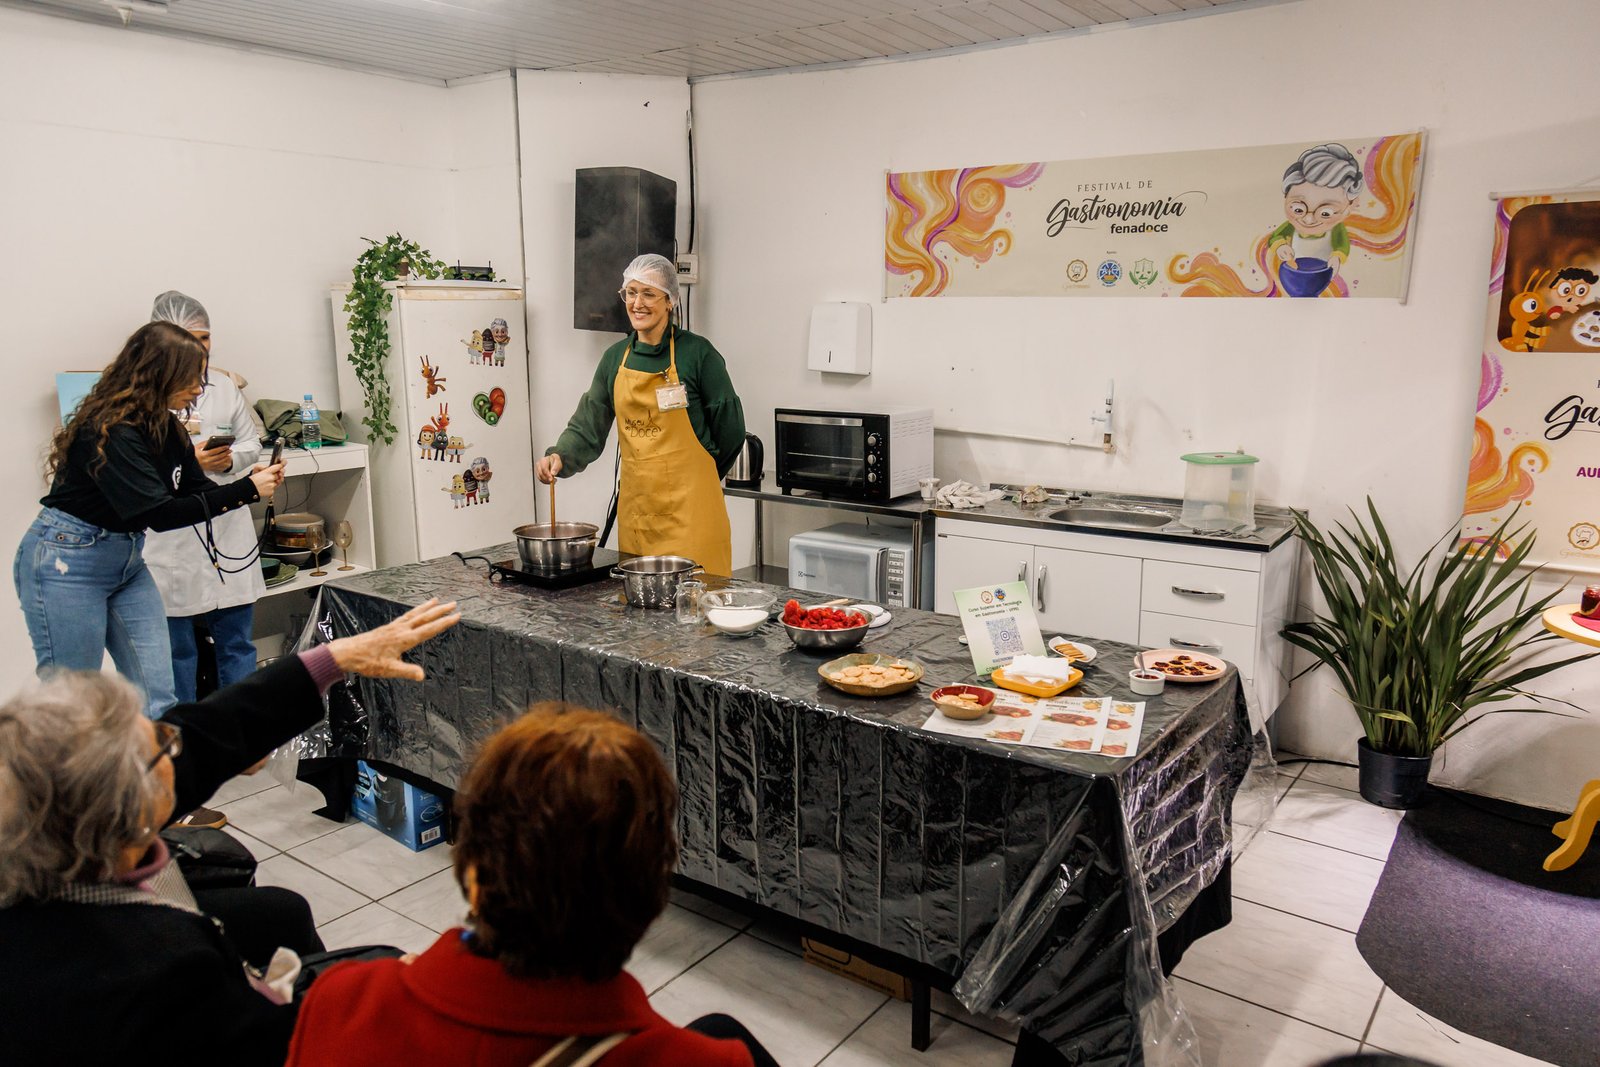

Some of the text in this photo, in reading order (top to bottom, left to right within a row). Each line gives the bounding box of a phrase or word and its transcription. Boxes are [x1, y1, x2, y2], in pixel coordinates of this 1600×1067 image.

[1077, 180, 1153, 192] FESTIVAL DE
[1046, 191, 1207, 237] Gastronomia
[1110, 222, 1168, 234] fenadoce
[1544, 395, 1600, 440] Ga
[1576, 466, 1600, 478] AU
